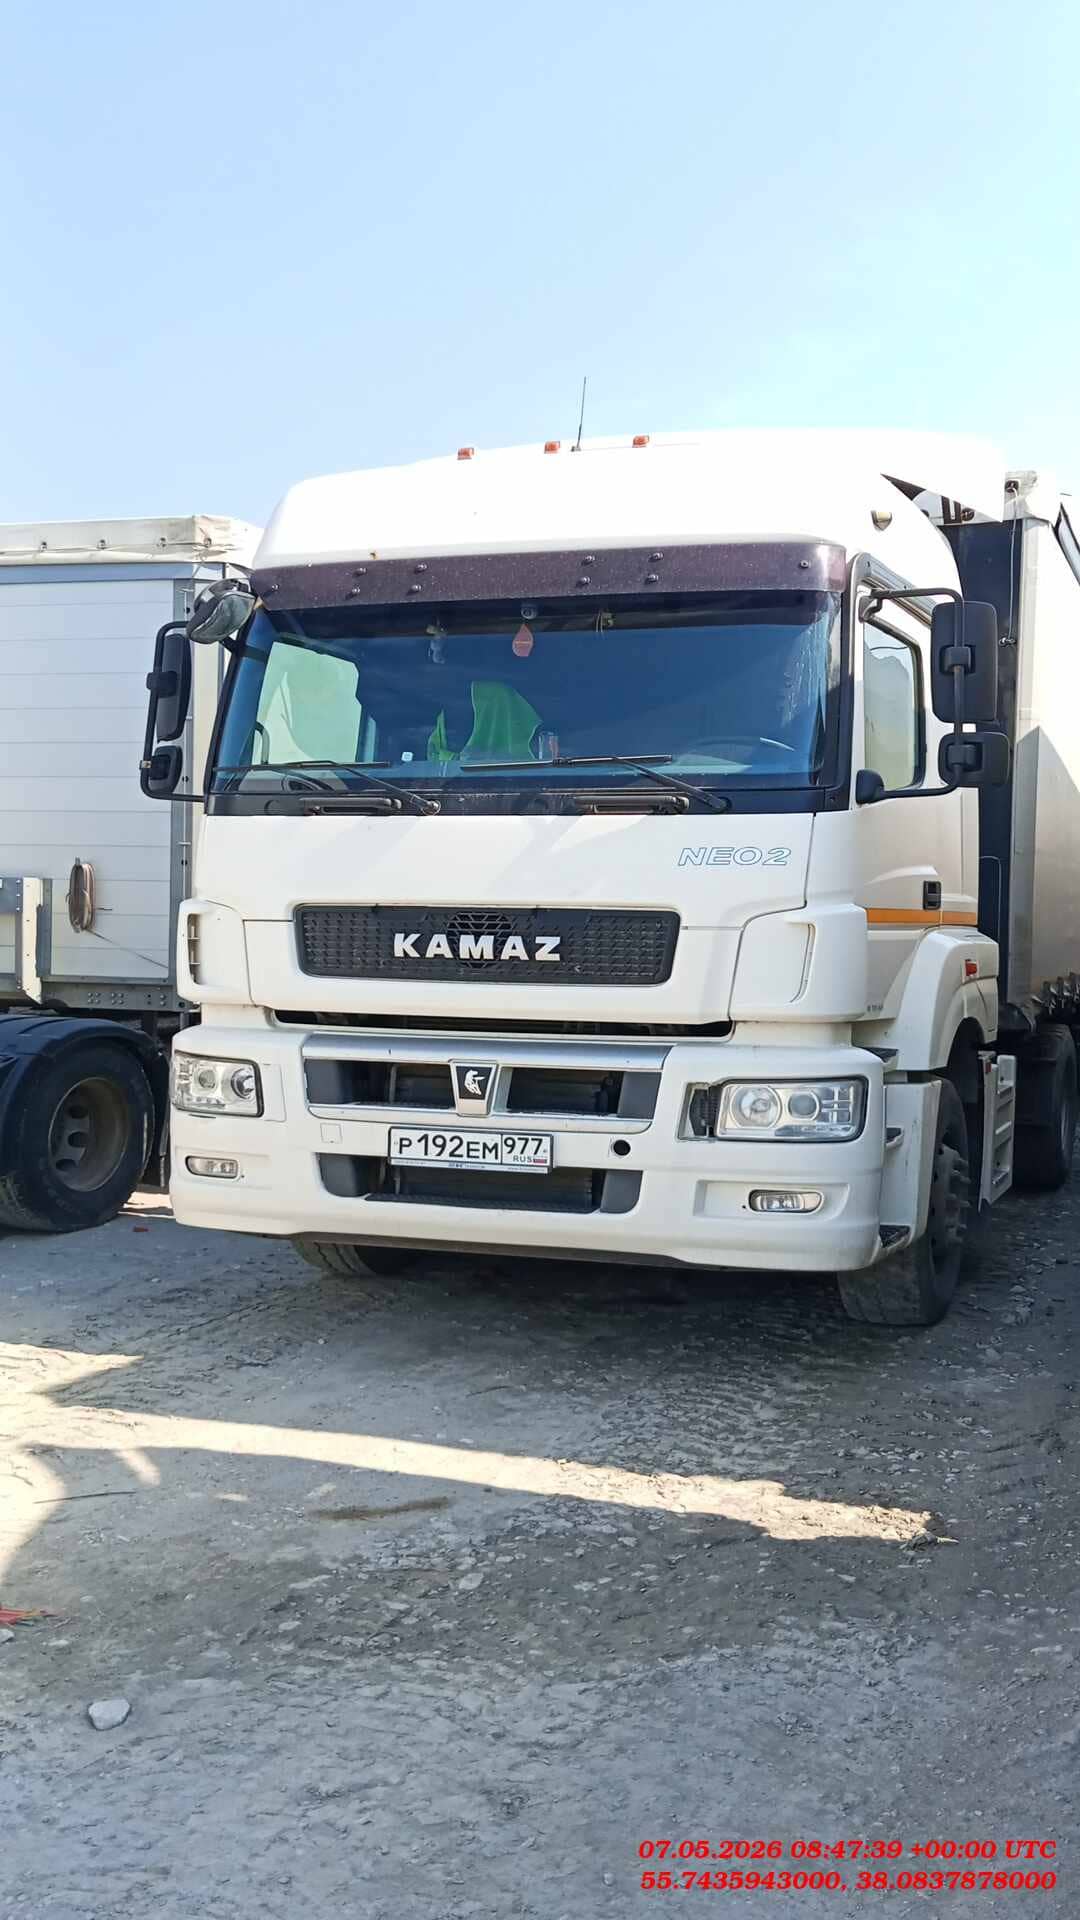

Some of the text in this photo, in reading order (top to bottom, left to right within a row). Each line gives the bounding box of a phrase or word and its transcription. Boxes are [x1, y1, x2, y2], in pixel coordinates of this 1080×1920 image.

[678, 847, 793, 866] NEO2
[394, 932, 562, 962] KAMAZ
[503, 1136, 544, 1156] 977
[512, 1155, 532, 1163] RUS
